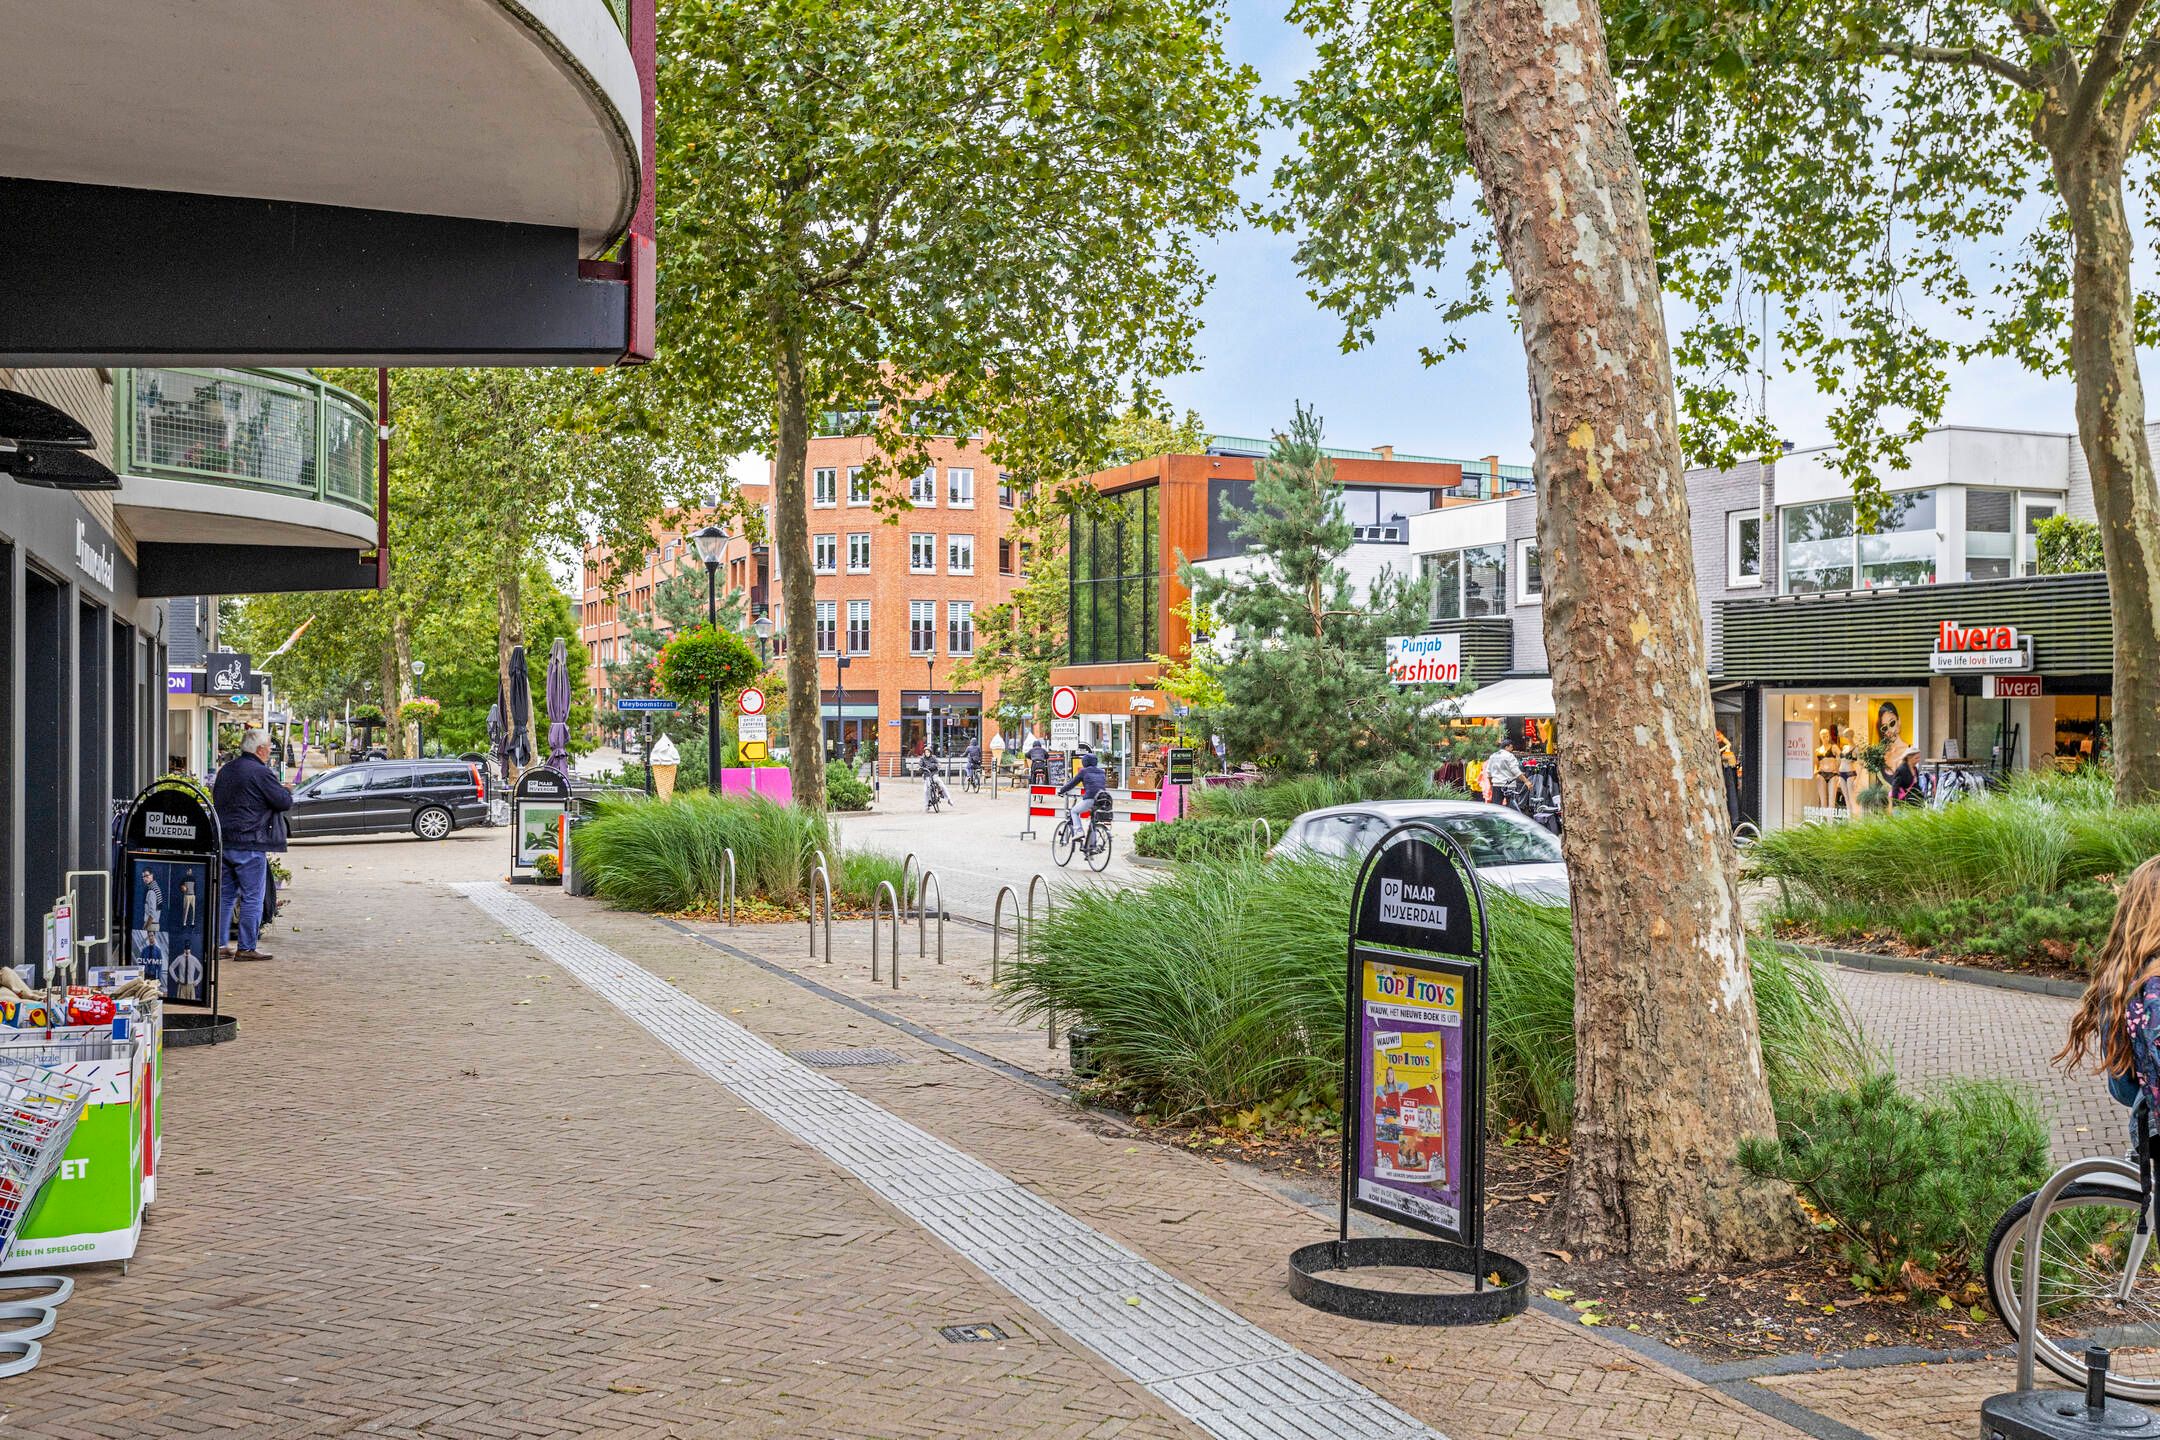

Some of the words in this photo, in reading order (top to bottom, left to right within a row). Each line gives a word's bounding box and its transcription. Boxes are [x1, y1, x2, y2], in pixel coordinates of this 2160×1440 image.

[1939, 620, 2011, 651] livera
[1402, 637, 1442, 656] Punjab
[1938, 655, 1952, 666] live
[1954, 655, 1967, 665] life
[1969, 656, 1986, 665] love
[1989, 655, 2013, 665] livera
[1996, 678, 2040, 696] livera
[621, 701, 673, 709] Meyboomstraat
[149, 814, 161, 822] OP
[164, 814, 188, 824] NAAR
[1384, 882, 1399, 897] OP
[1403, 884, 1435, 902] NAAR
[1383, 904, 1442, 925] NIJVERDAL
[1390, 1008, 1399, 1017] HET
[1400, 1010, 1422, 1020] NIEUWE
[1423, 1012, 1440, 1021] BOEK
[1441, 1014, 1446, 1022] IS
[47, 1243, 96, 1254] SPEELGOED
